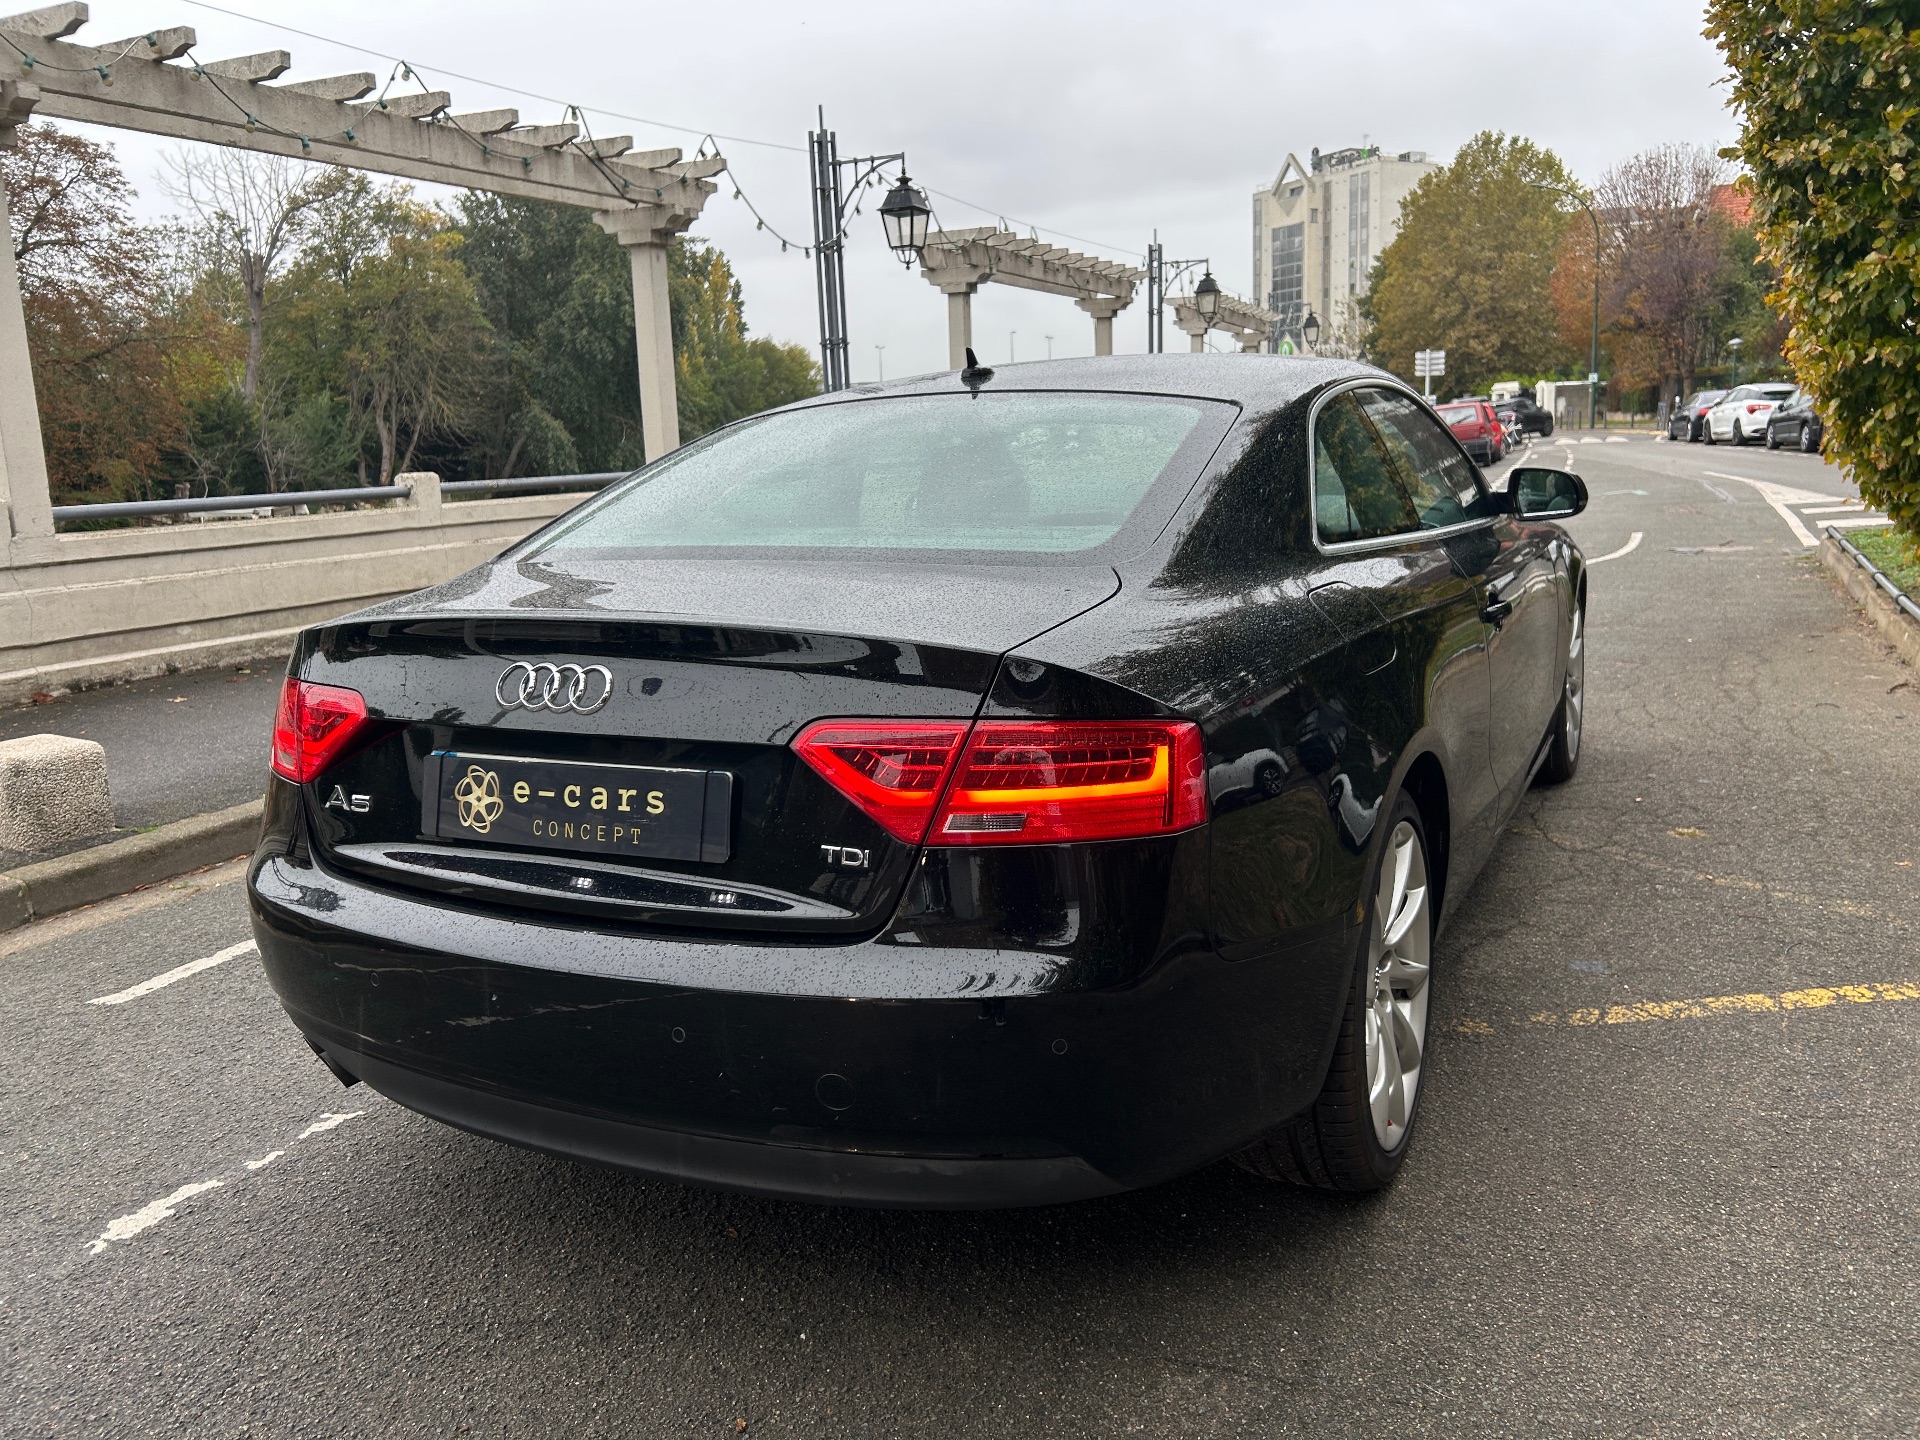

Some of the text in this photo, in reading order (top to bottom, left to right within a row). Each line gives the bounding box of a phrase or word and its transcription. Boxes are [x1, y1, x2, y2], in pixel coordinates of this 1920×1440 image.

[324, 784, 371, 813] A5
[512, 779, 667, 815] e-cars
[533, 819, 642, 846] CONCEPT
[820, 844, 870, 868] TDI
